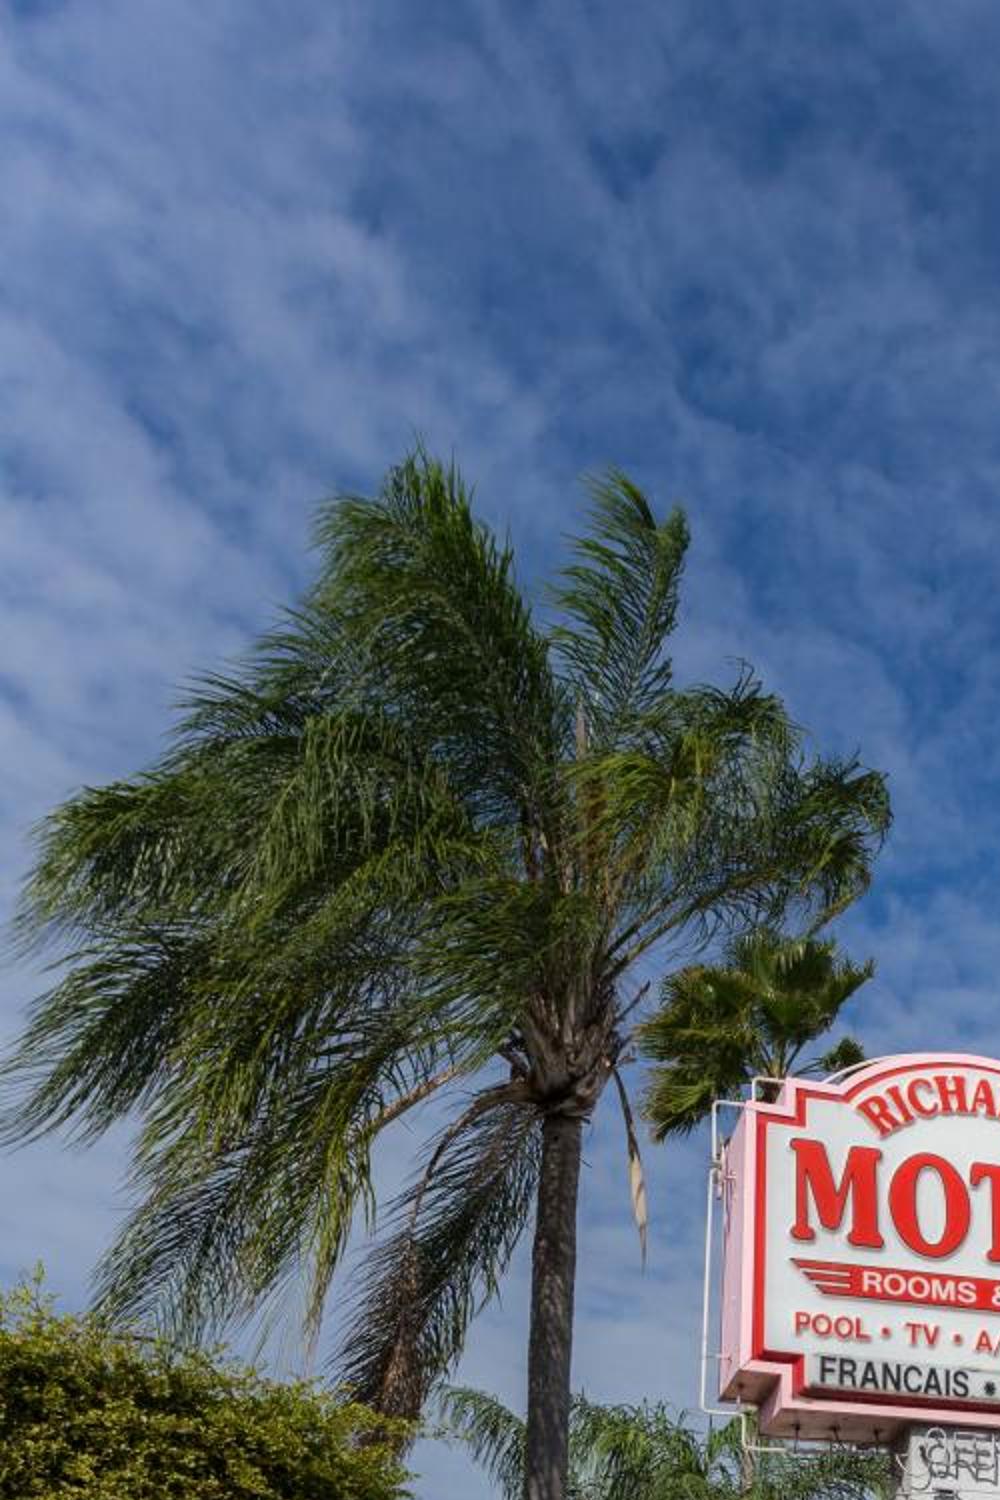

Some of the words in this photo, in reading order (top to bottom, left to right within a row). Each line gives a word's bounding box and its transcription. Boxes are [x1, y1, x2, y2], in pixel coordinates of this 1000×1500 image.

[861, 1270, 977, 1304] ROOMS
[794, 1311, 872, 1342] POOL
[905, 1322, 941, 1347] TV
[818, 1356, 970, 1398] FRANCAIS
